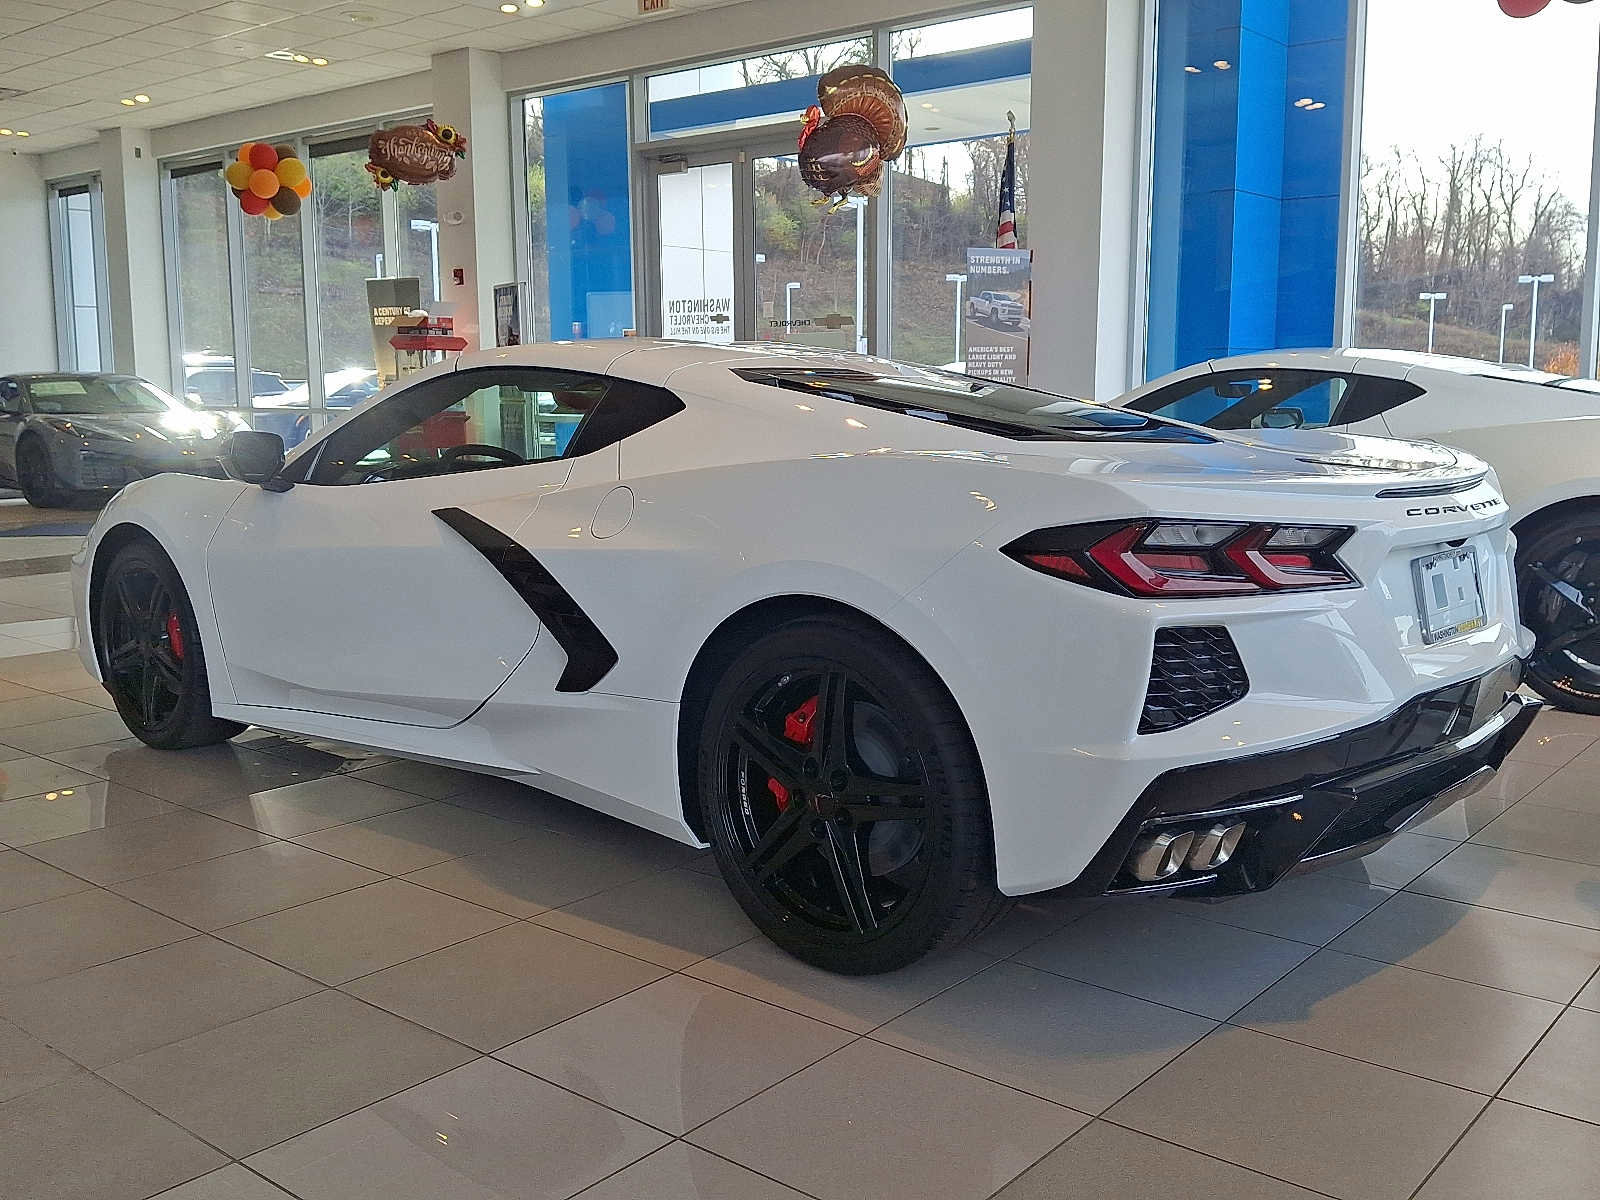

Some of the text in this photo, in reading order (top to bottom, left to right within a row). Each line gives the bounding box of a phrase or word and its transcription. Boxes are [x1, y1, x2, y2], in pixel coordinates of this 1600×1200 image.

[970, 255, 1021, 265] STRENGTH IN
[969, 265, 1010, 275] NUMBERS.
[373, 307, 379, 316] A
[379, 306, 403, 316] CENTURY
[1406, 498, 1501, 517] CORVETTE
